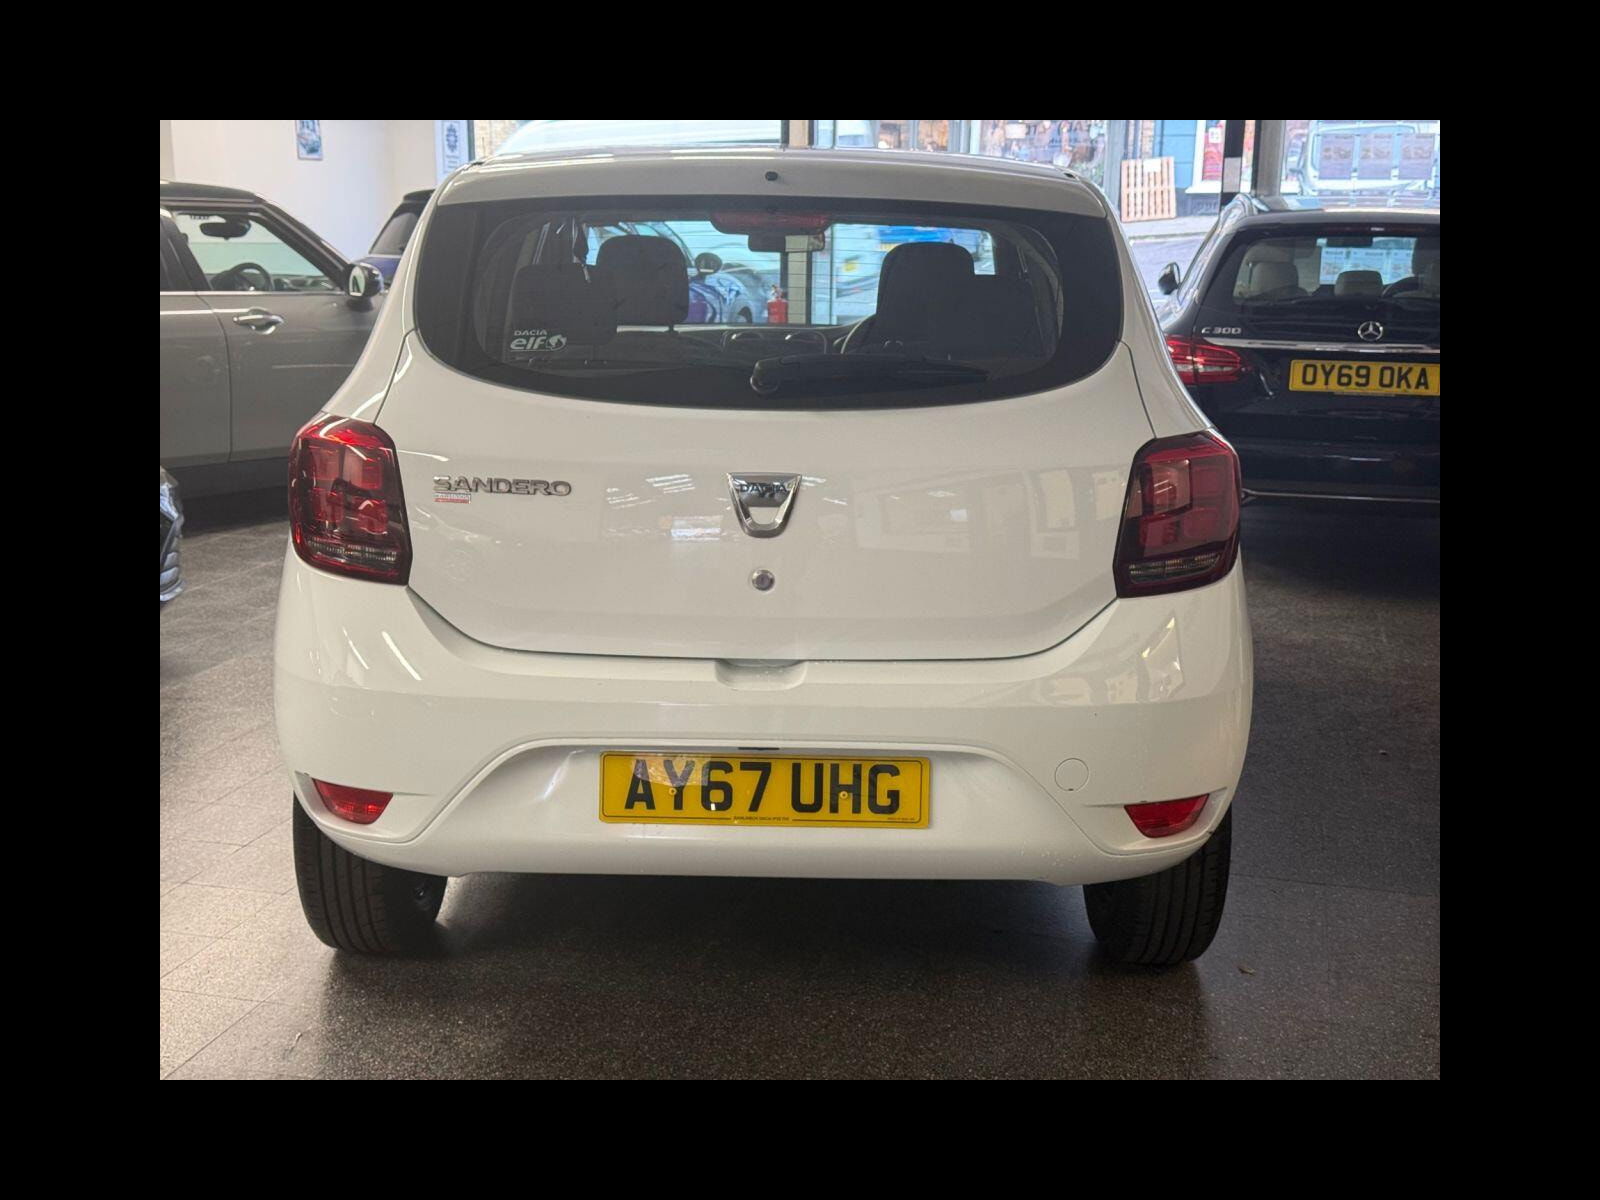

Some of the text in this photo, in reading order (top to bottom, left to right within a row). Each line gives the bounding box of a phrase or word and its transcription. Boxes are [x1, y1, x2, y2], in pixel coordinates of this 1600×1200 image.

[1302, 364, 1429, 390] OY69 OKA
[433, 476, 571, 496] SANDERO
[740, 483, 787, 493] DACIA
[624, 759, 901, 815] AY67 UHG
